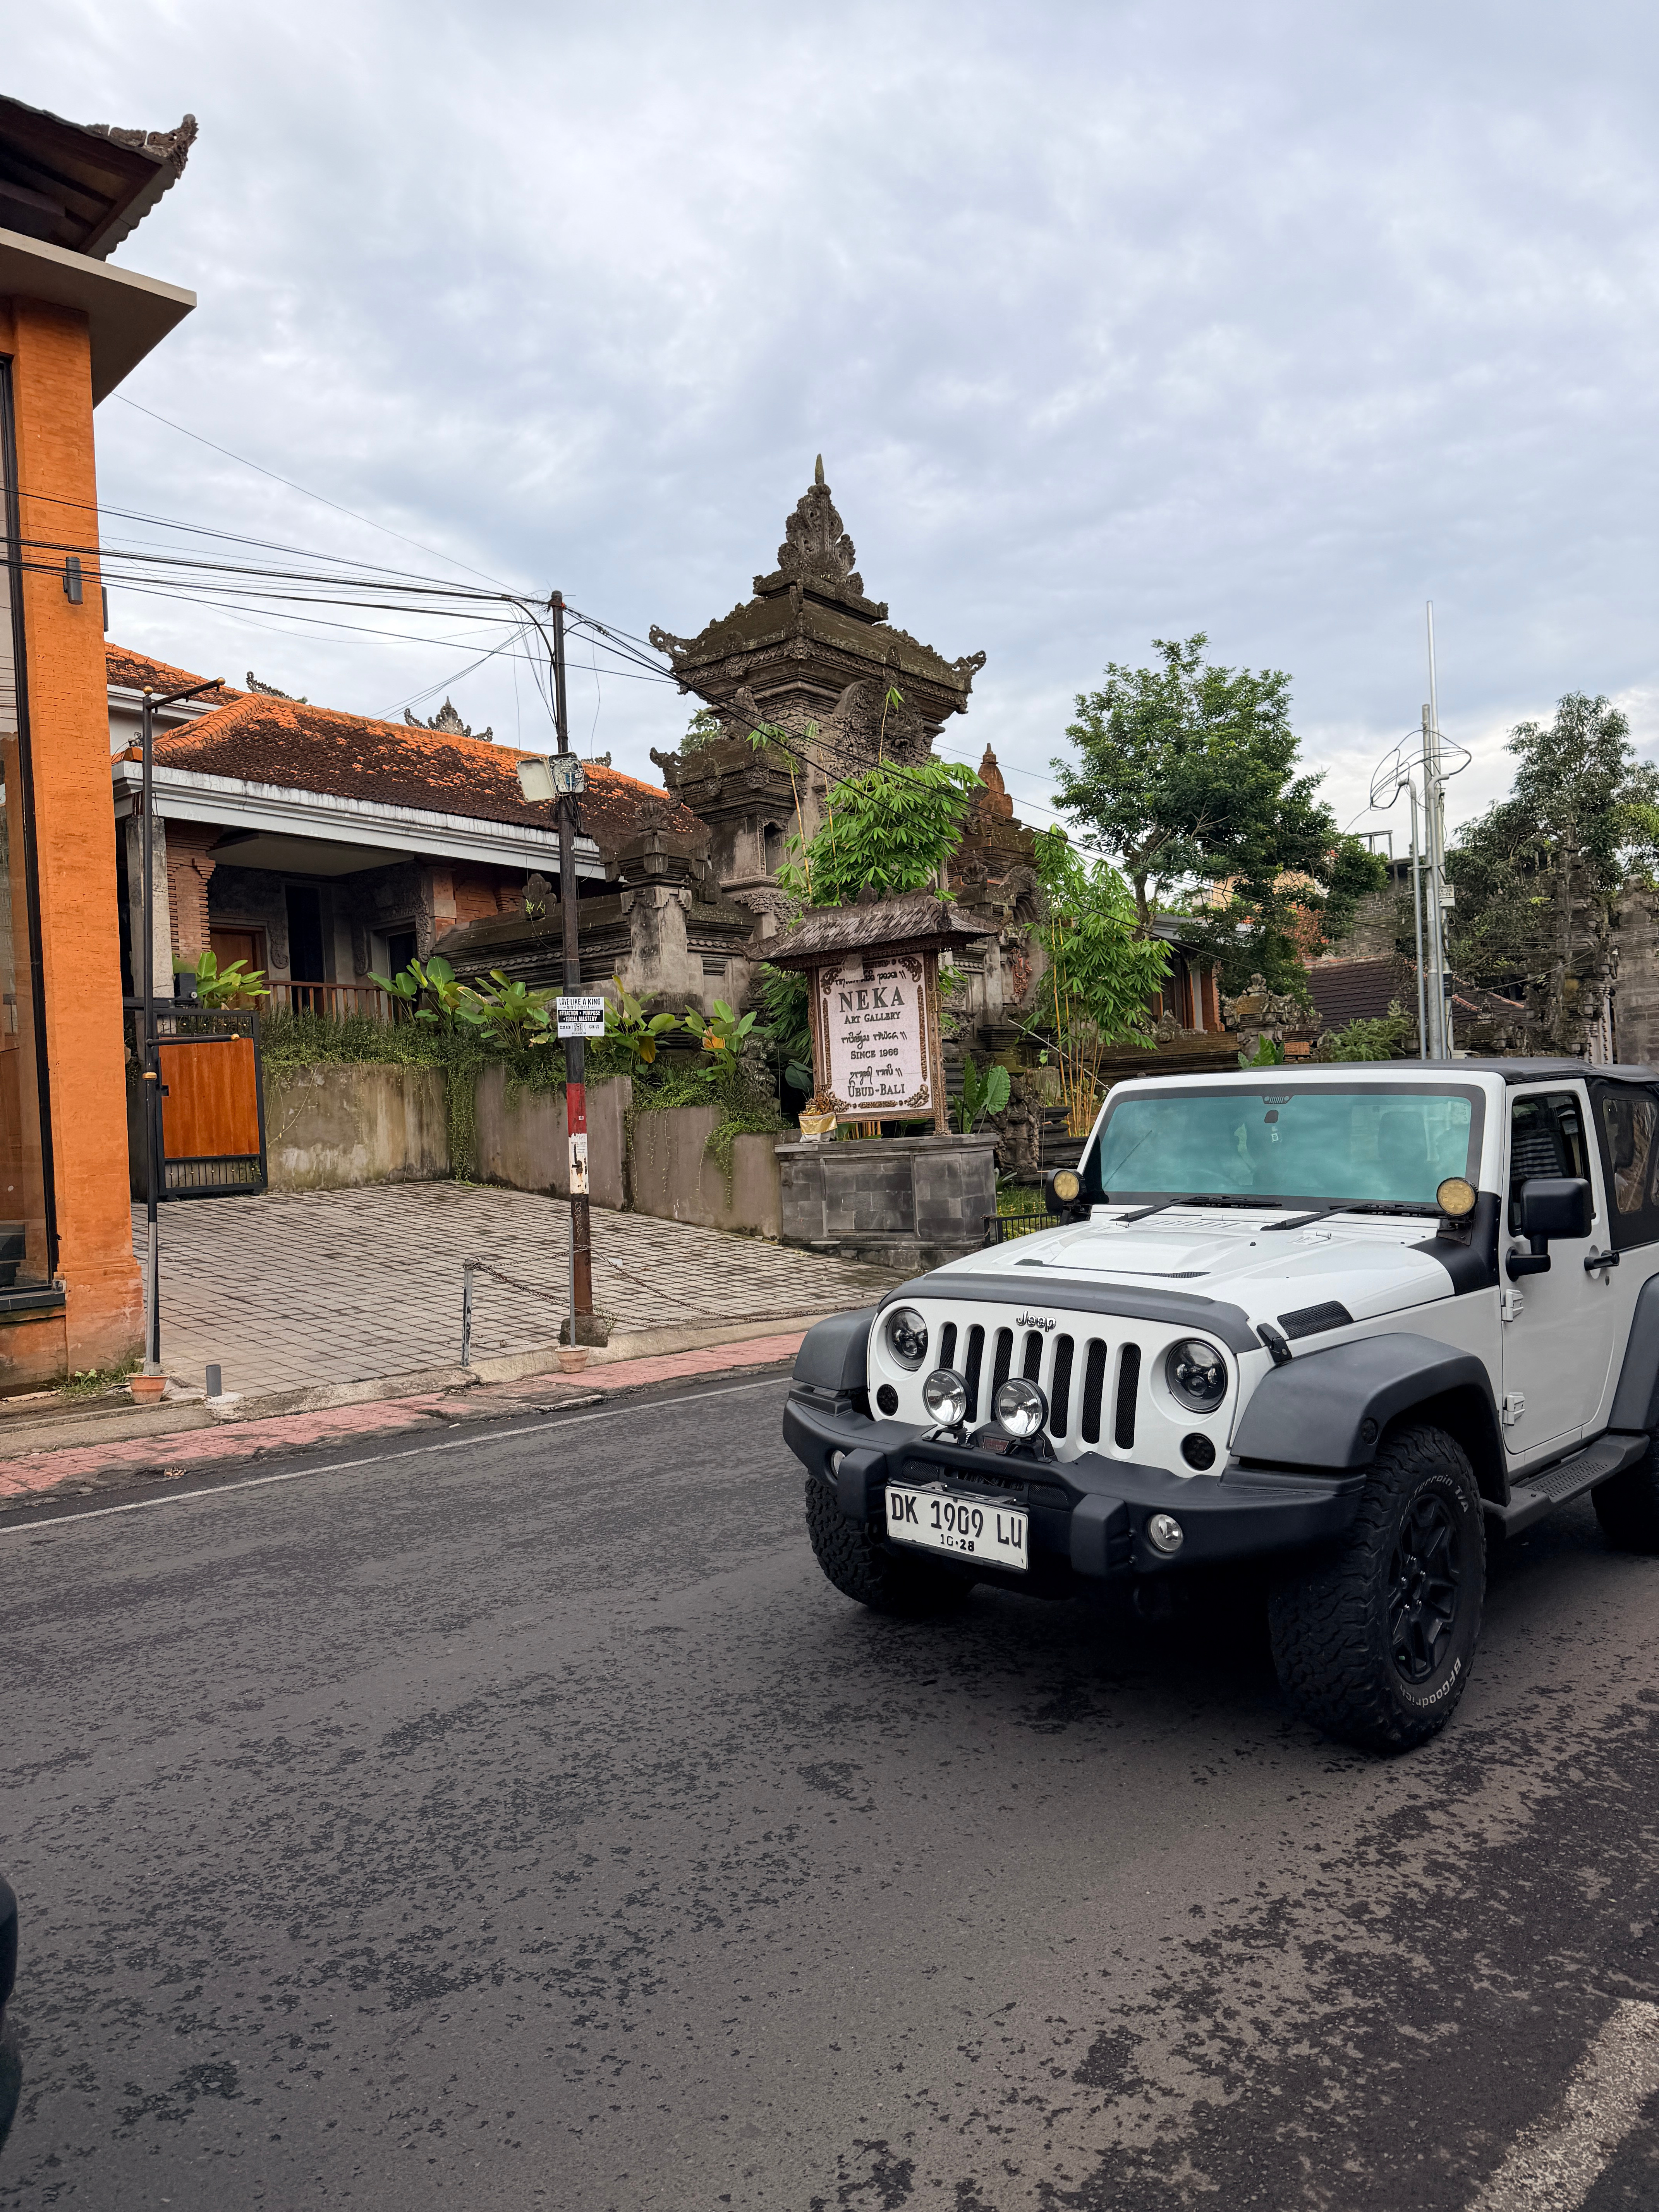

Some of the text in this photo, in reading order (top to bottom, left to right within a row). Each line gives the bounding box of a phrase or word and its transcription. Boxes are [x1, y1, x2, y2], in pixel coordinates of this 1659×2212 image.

[838, 986, 905, 1012] NEKA
[844, 1012, 901, 1024] ART GALLERY
[851, 1048, 898, 1060] SINCE 1966
[848, 1084, 905, 1097] UBUD-BALI
[1016, 1310, 1056, 1332] Jeep
[1455, 1485, 1469, 1513] T/A
[891, 1492, 1022, 1549] DK 1909 LU
[1400, 1657, 1462, 1708] BFGoodrich
